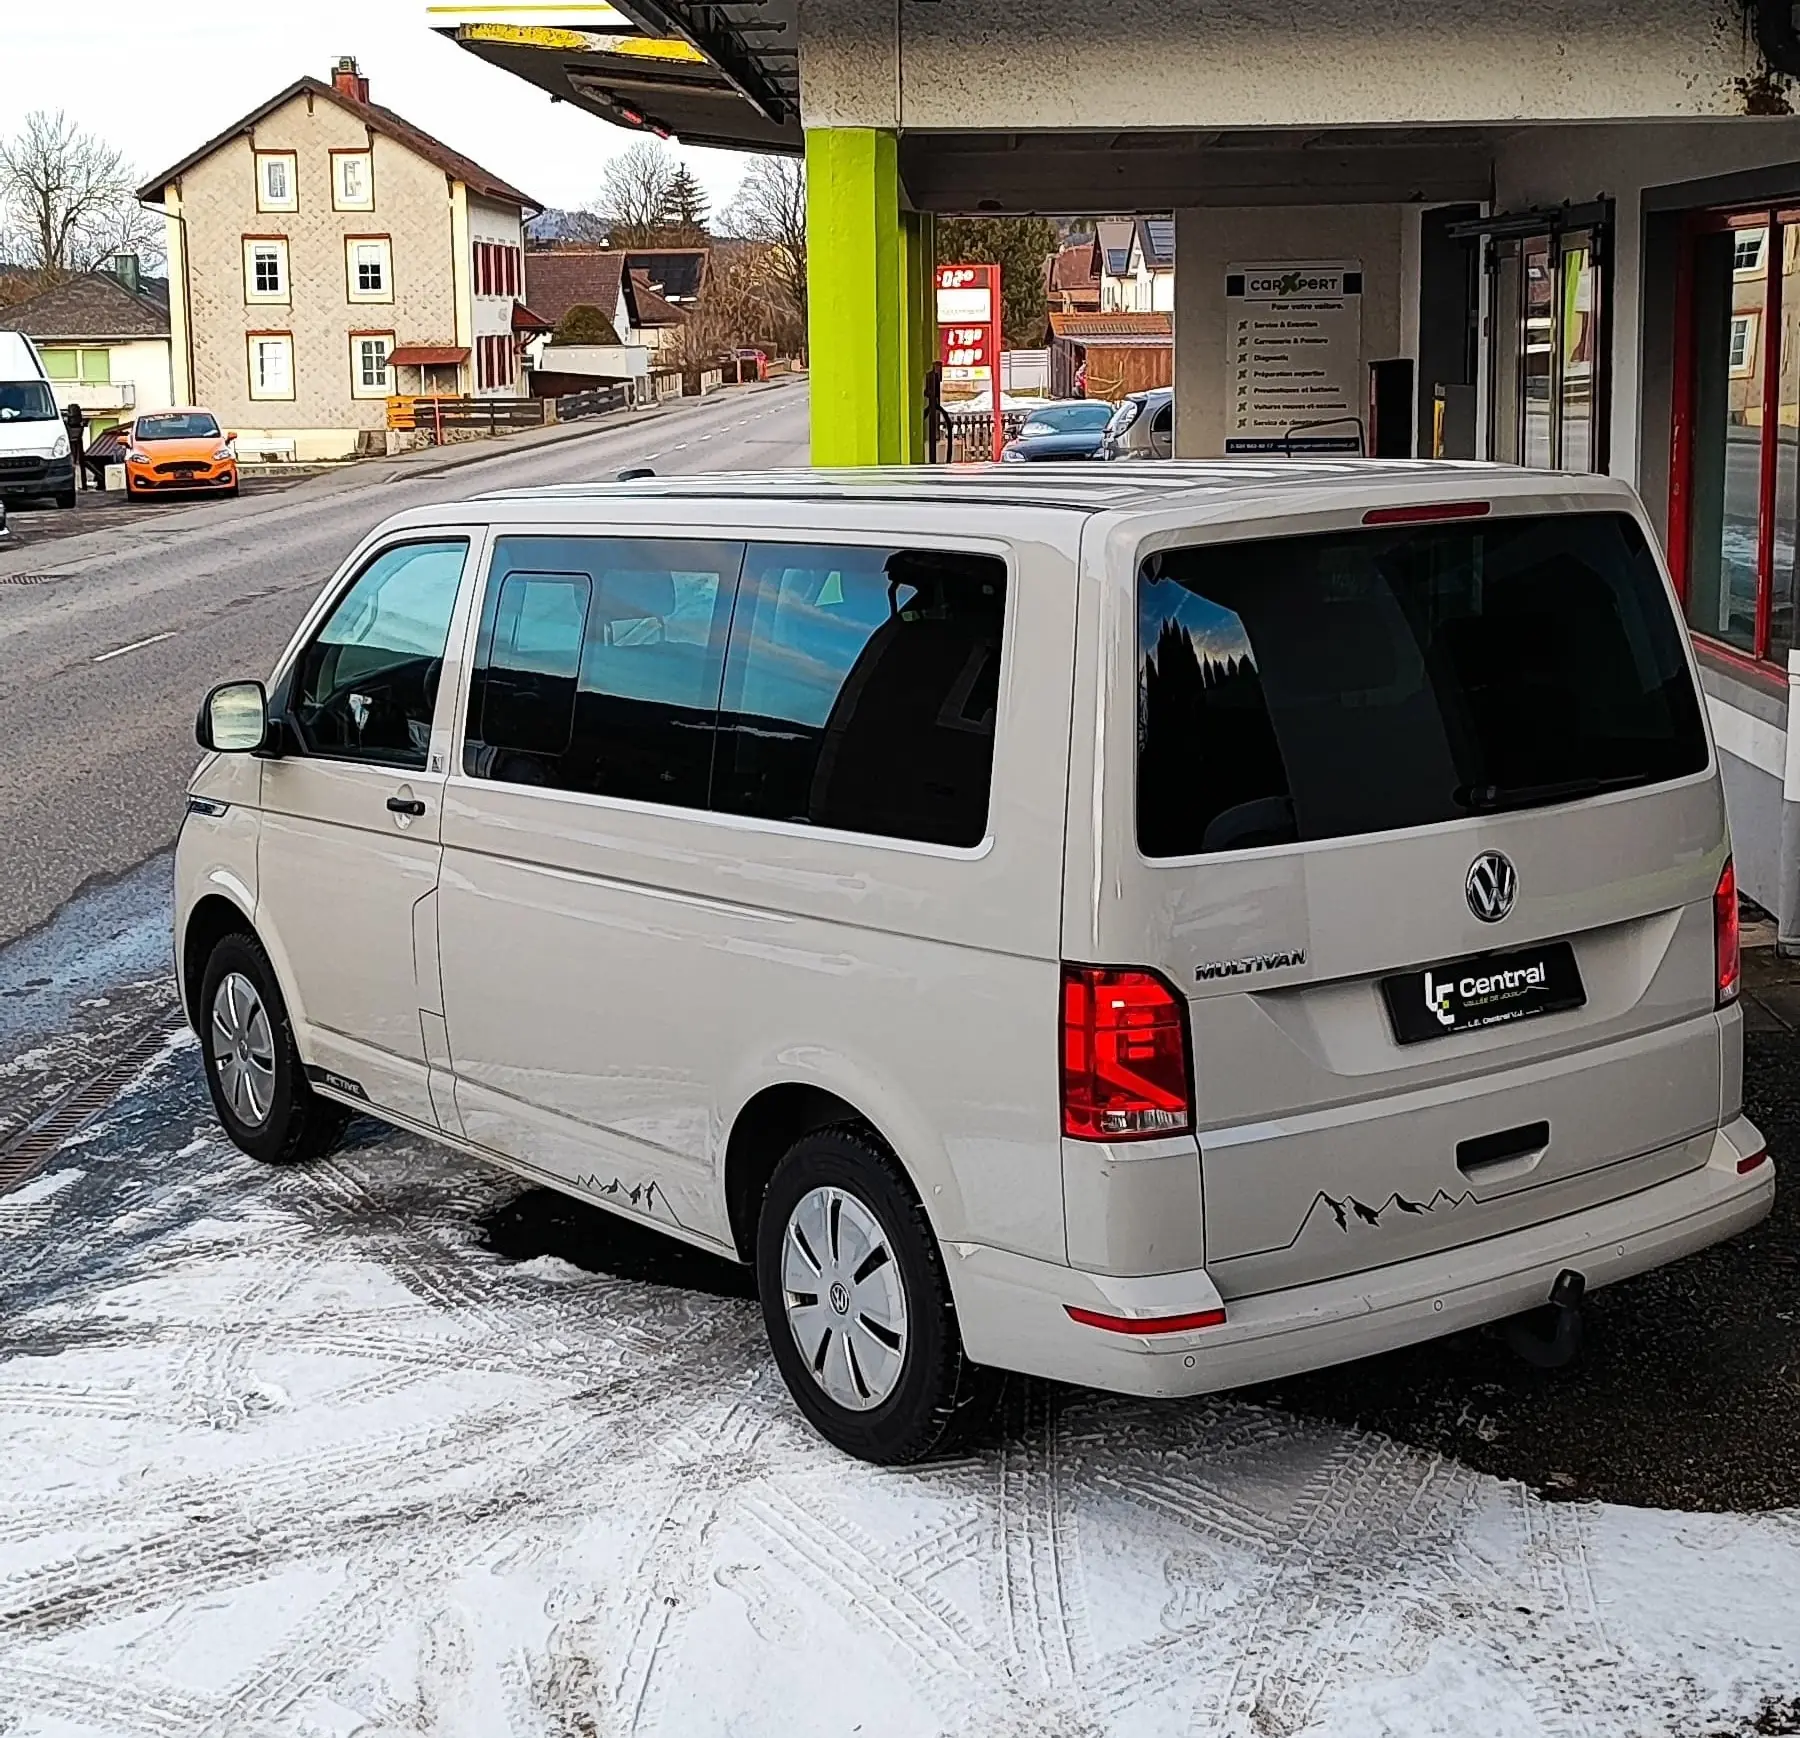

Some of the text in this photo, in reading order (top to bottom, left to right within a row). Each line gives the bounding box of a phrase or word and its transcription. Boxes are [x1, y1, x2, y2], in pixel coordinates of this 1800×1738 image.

[1291, 303, 1313, 311] votre
[1195, 948, 1307, 982] MULTIVAN
[1459, 962, 1546, 998] Central
[325, 1072, 361, 1095] ACTIVE
